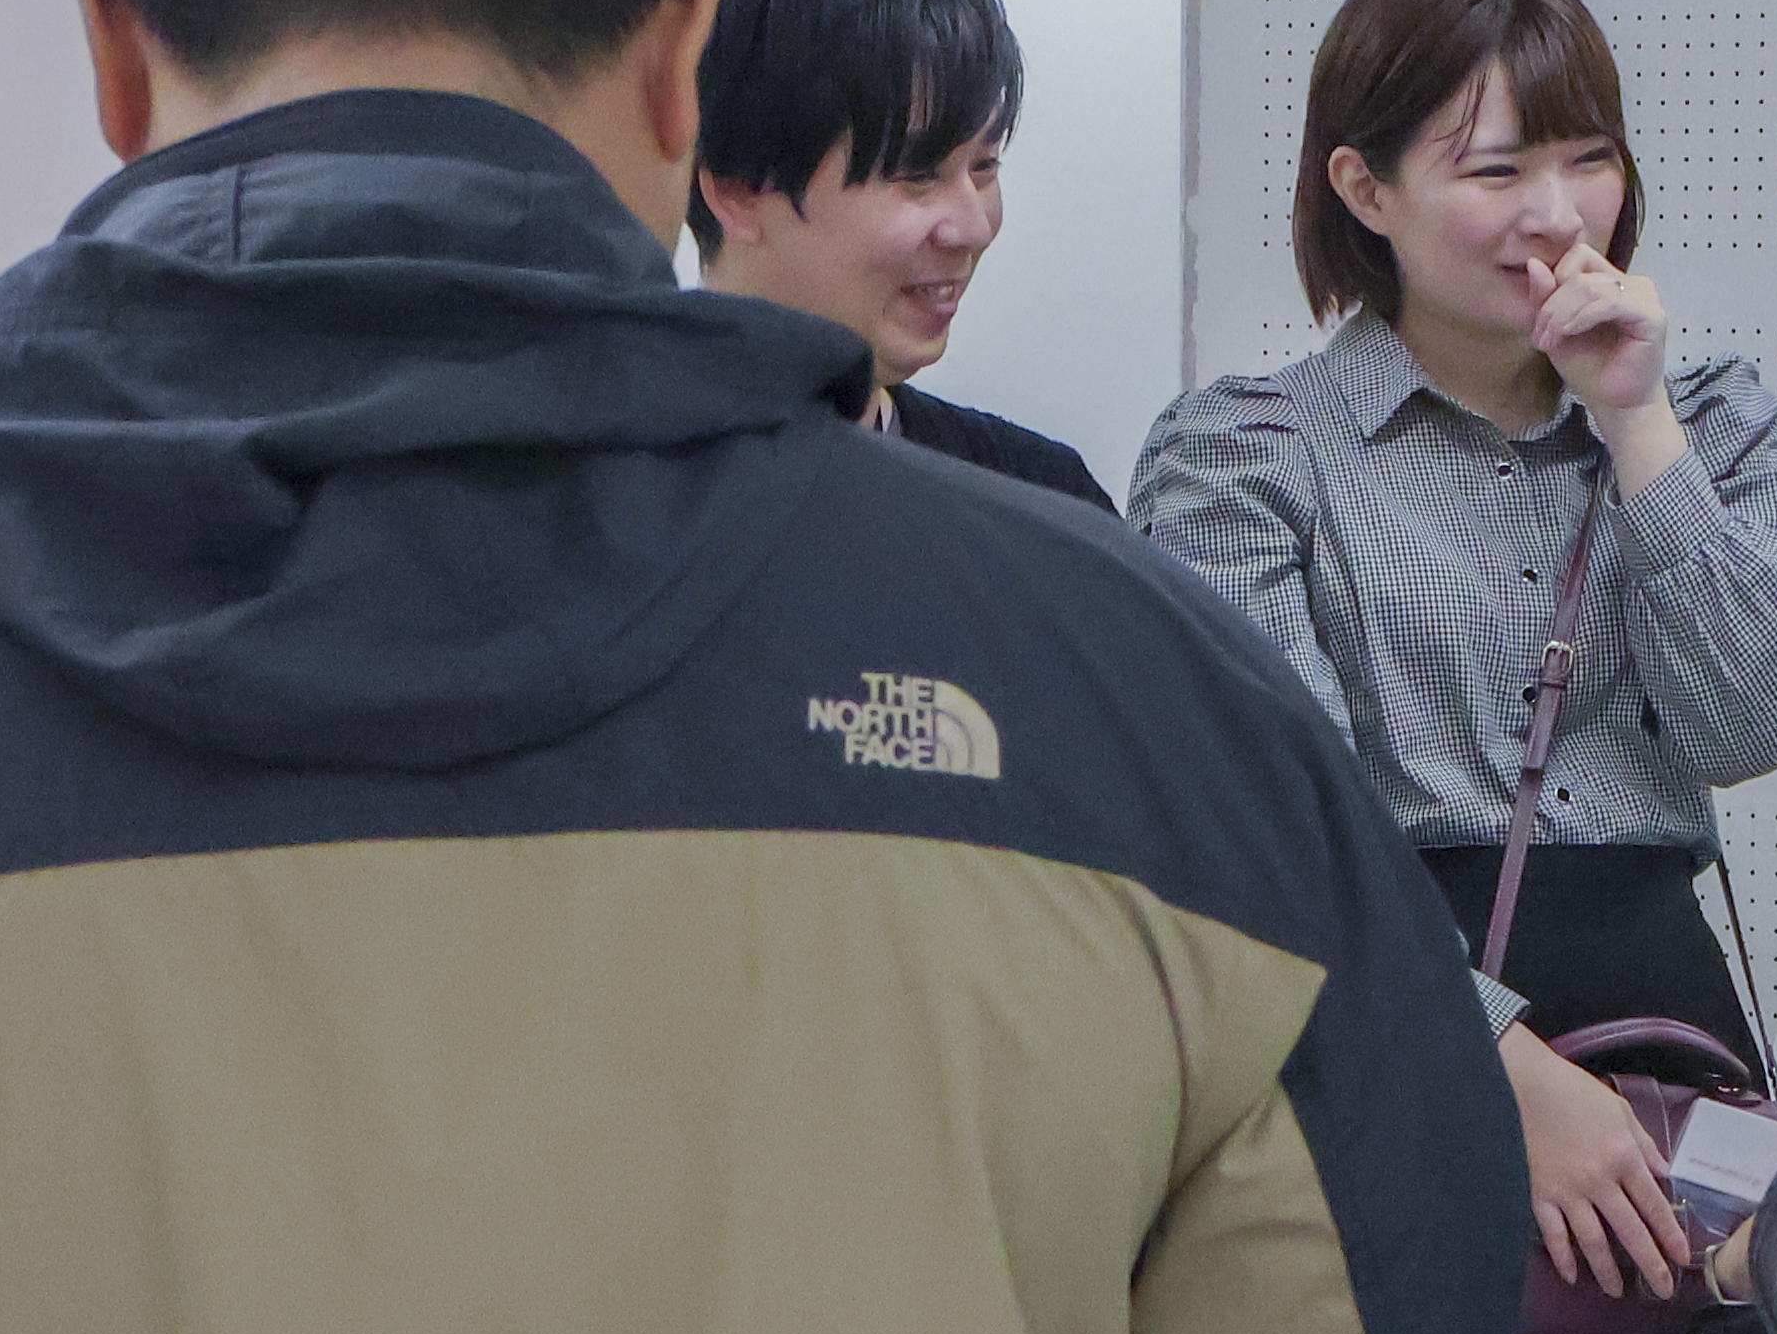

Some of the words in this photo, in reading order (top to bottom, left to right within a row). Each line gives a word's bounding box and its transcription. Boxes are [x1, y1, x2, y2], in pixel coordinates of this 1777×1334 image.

[861, 671, 934, 707] THE
[808, 698, 933, 740] NORTH
[844, 732, 934, 772] FACE
